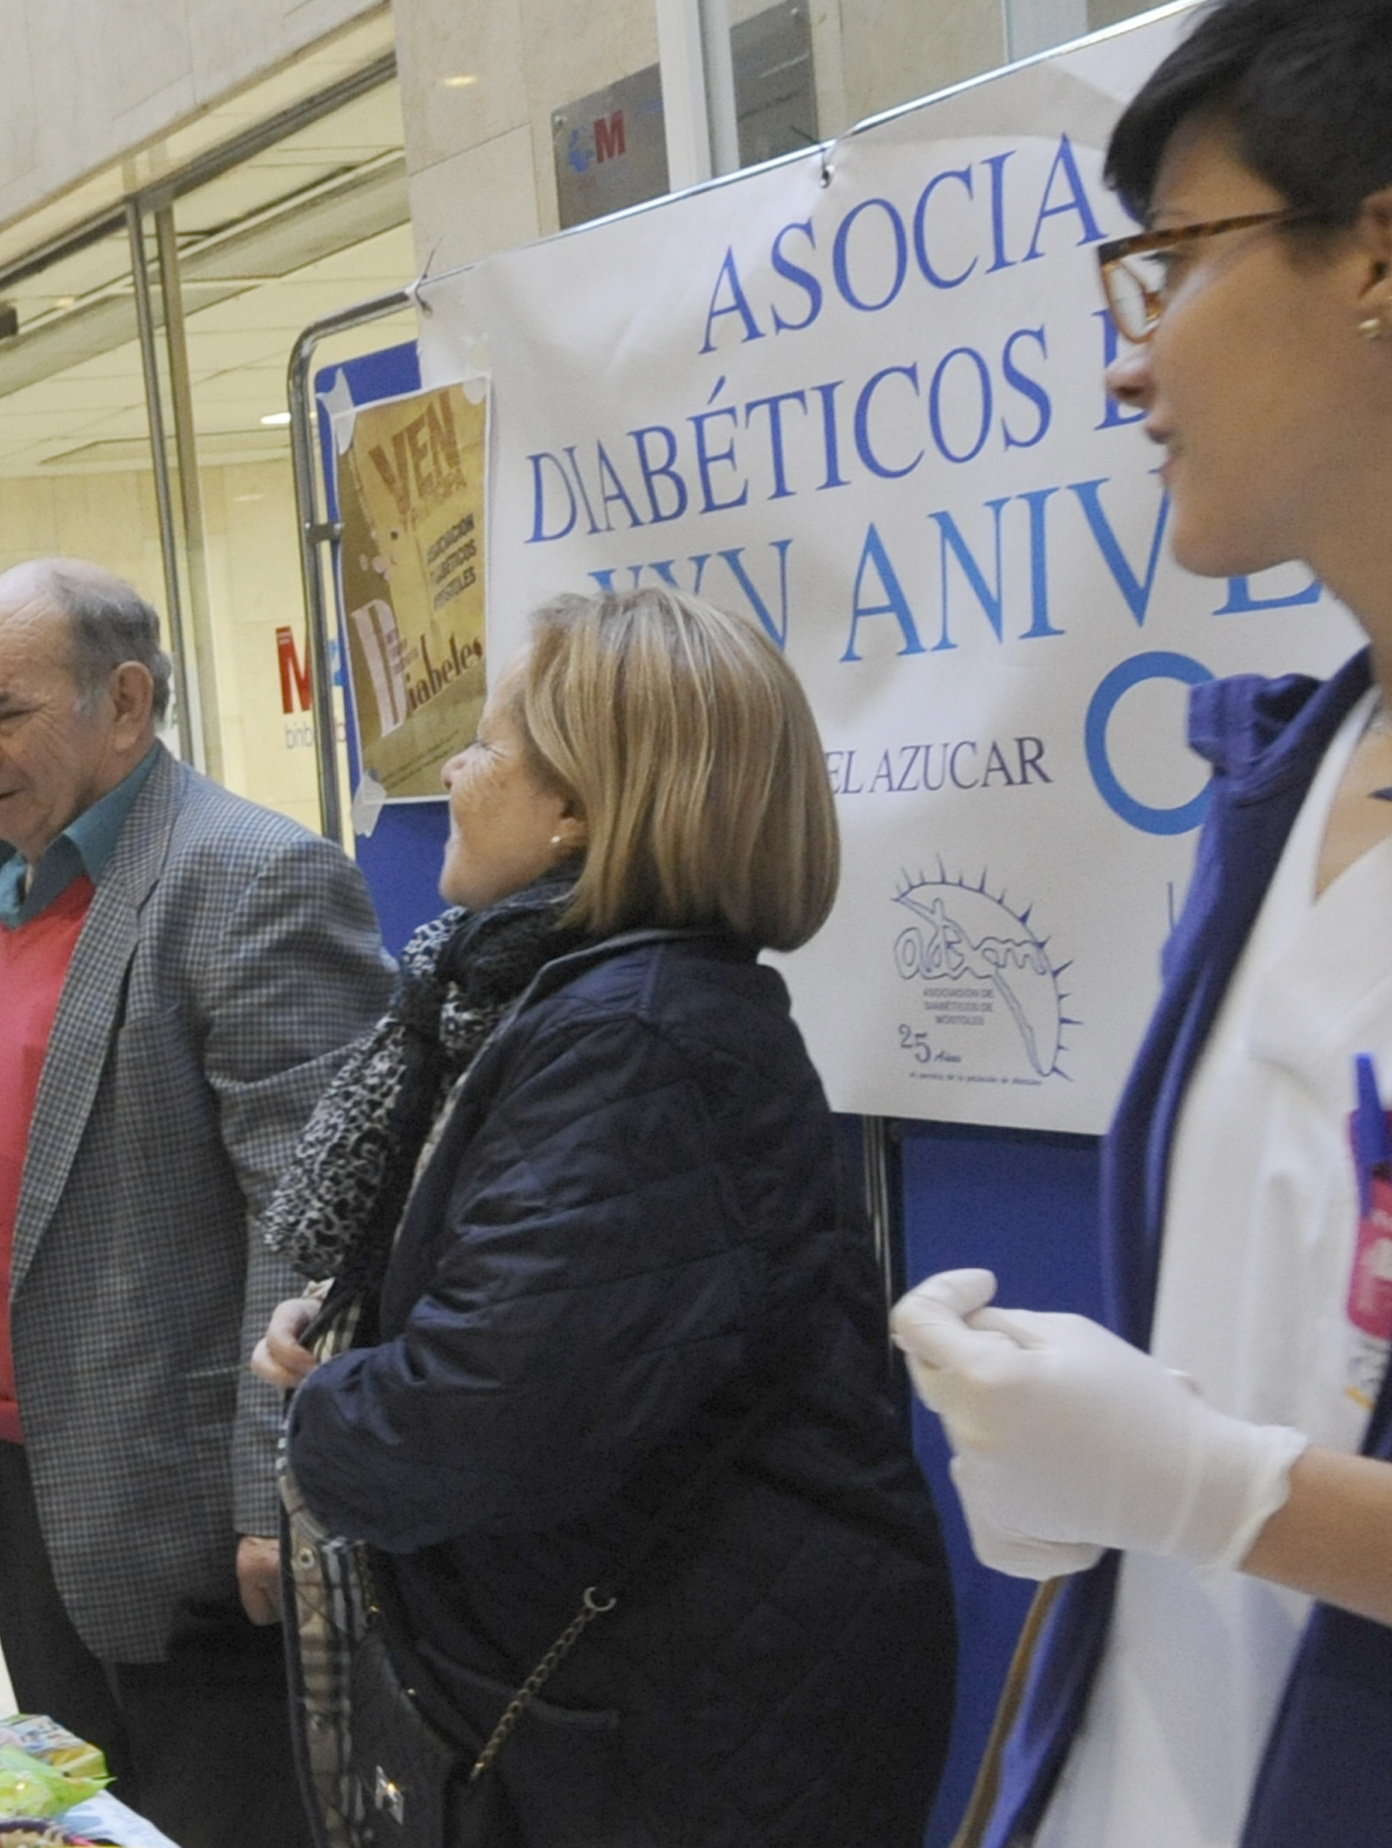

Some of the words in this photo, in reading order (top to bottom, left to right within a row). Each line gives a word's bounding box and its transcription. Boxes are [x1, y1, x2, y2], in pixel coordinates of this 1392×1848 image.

[698, 131, 1144, 355] ASOCIA
[368, 389, 461, 517] VEN
[523, 323, 1053, 546] DIABÉTICOS
[838, 467, 1324, 665] ANIV
[868, 736, 1055, 793] AZUCAR
